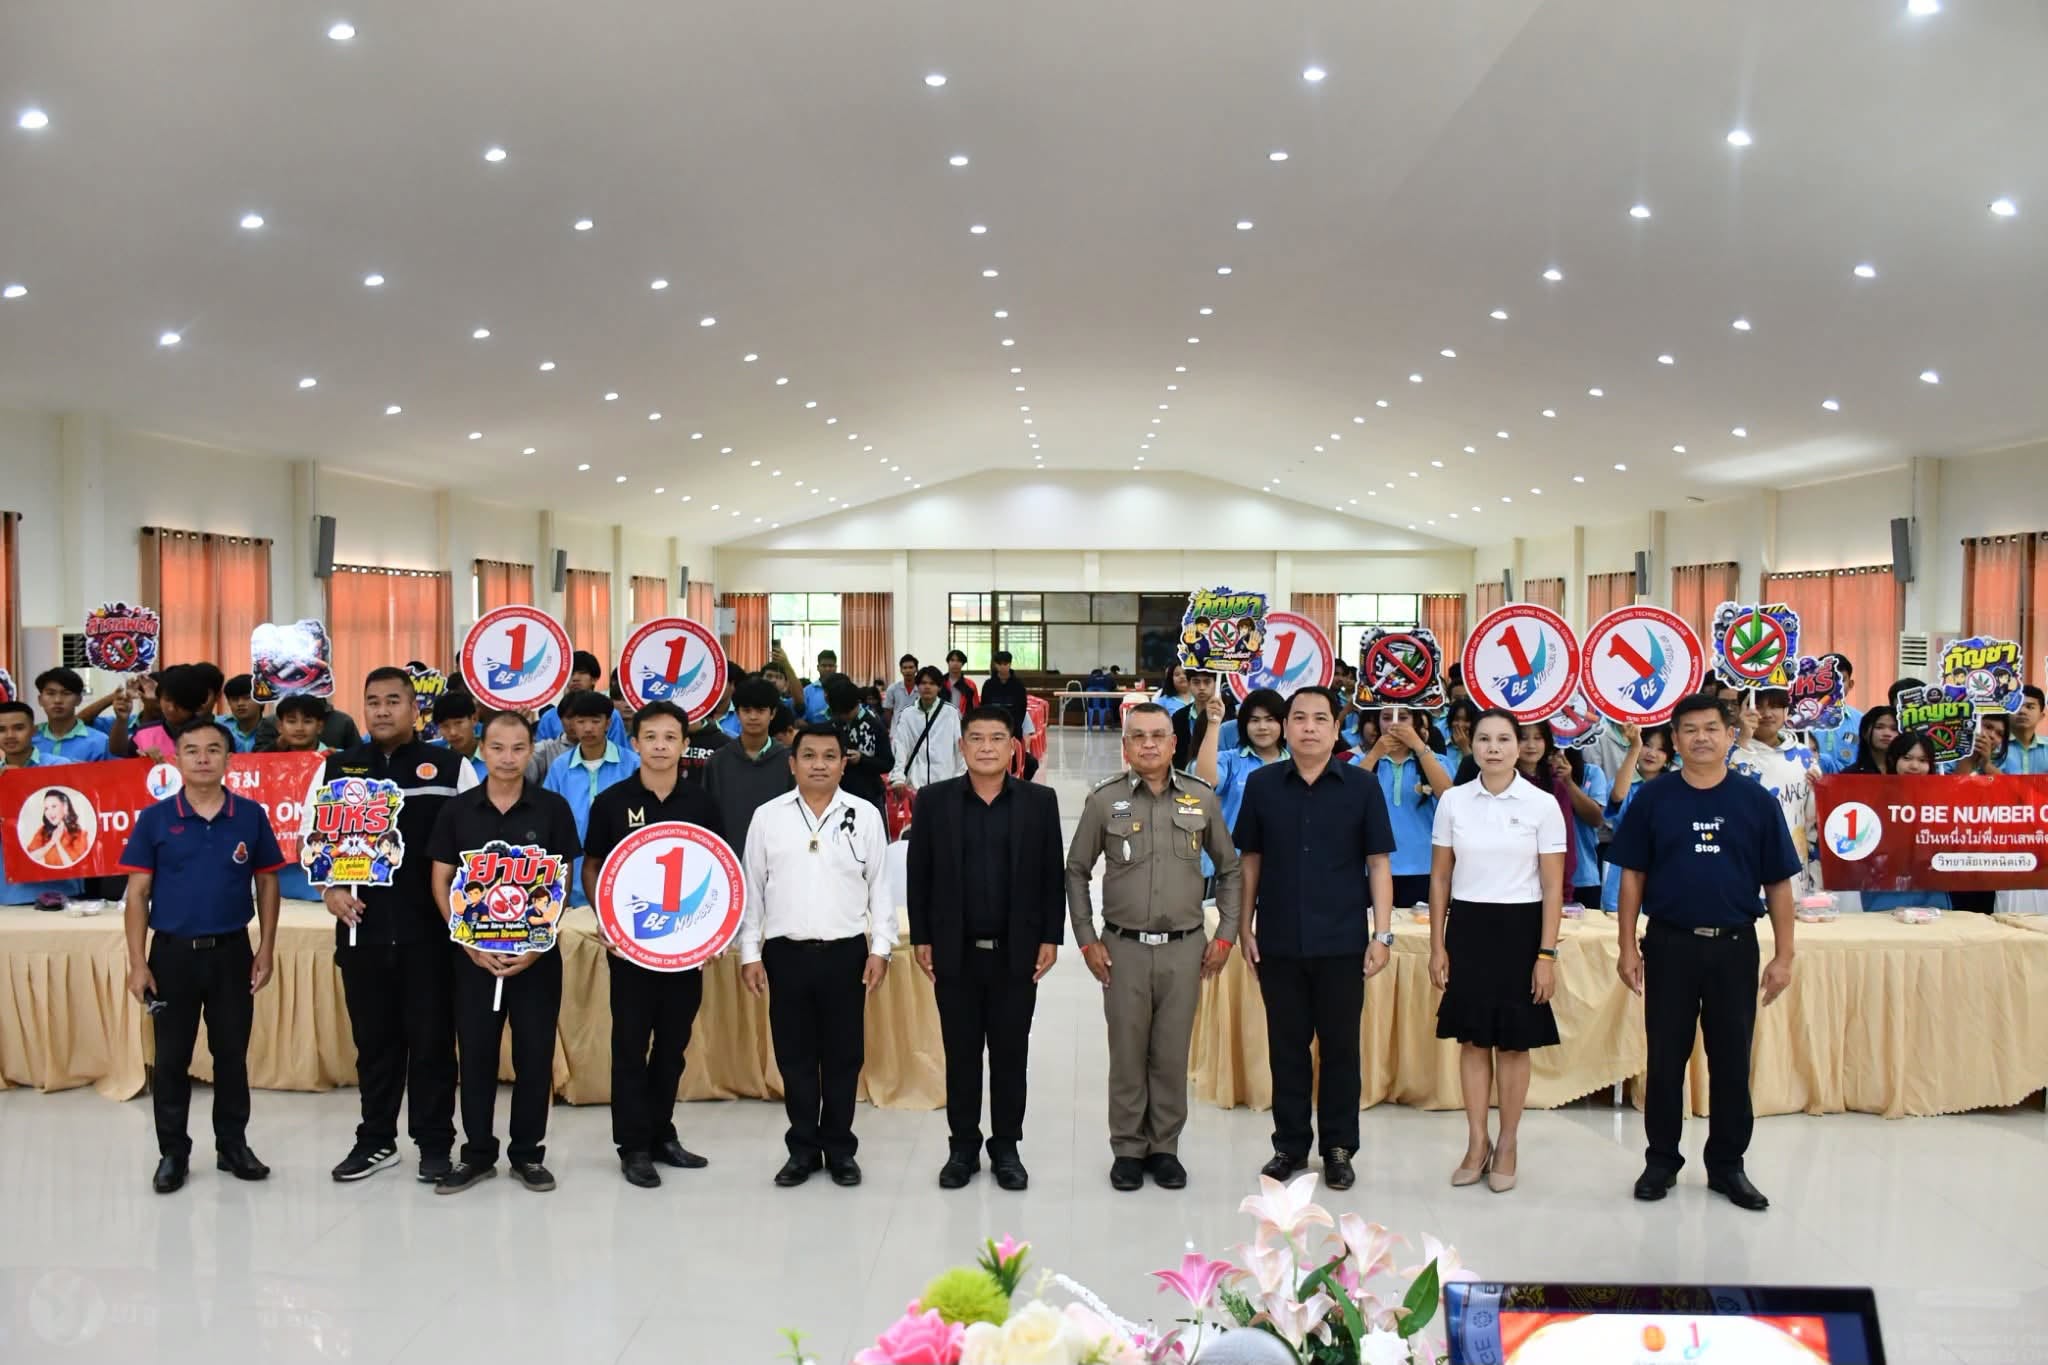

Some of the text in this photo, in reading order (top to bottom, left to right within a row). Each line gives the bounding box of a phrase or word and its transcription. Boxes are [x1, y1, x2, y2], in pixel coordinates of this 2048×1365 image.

[1193, 588, 1263, 618] กัญชา
[505, 623, 527, 672] 1
[665, 636, 687, 684] 1
[1272, 631, 1297, 676] 1
[1496, 624, 1532, 678] 1
[1608, 633, 1655, 679] 1
[1944, 644, 2017, 674] กัญชา
[495, 671, 515, 684] BE
[1511, 679, 1528, 697] BE
[1640, 678, 1657, 700] BE
[1902, 702, 1971, 727] กัญชา
[100, 811, 129, 832] TO
[1692, 821, 1720, 831] Start
[1843, 808, 1857, 841] 1
[1888, 805, 1916, 823] TO
[1920, 805, 1949, 823] BE
[1953, 805, 2034, 823] NUMBER
[625, 836, 641, 851] ONE
[1694, 843, 1721, 854] Stop
[1701, 832, 1714, 841] to
[468, 848, 557, 885] ยาบ้า
[607, 847, 629, 874] NUMBER
[713, 845, 738, 878] TECHNICAL
[1937, 855, 2032, 867] วิทยาลัยเทคนิคเทิง
[602, 885, 610, 896] TO
[603, 873, 613, 885] BE
[656, 846, 684, 912] 1
[732, 878, 741, 911] COLLEGE
[642, 912, 669, 931] BE
